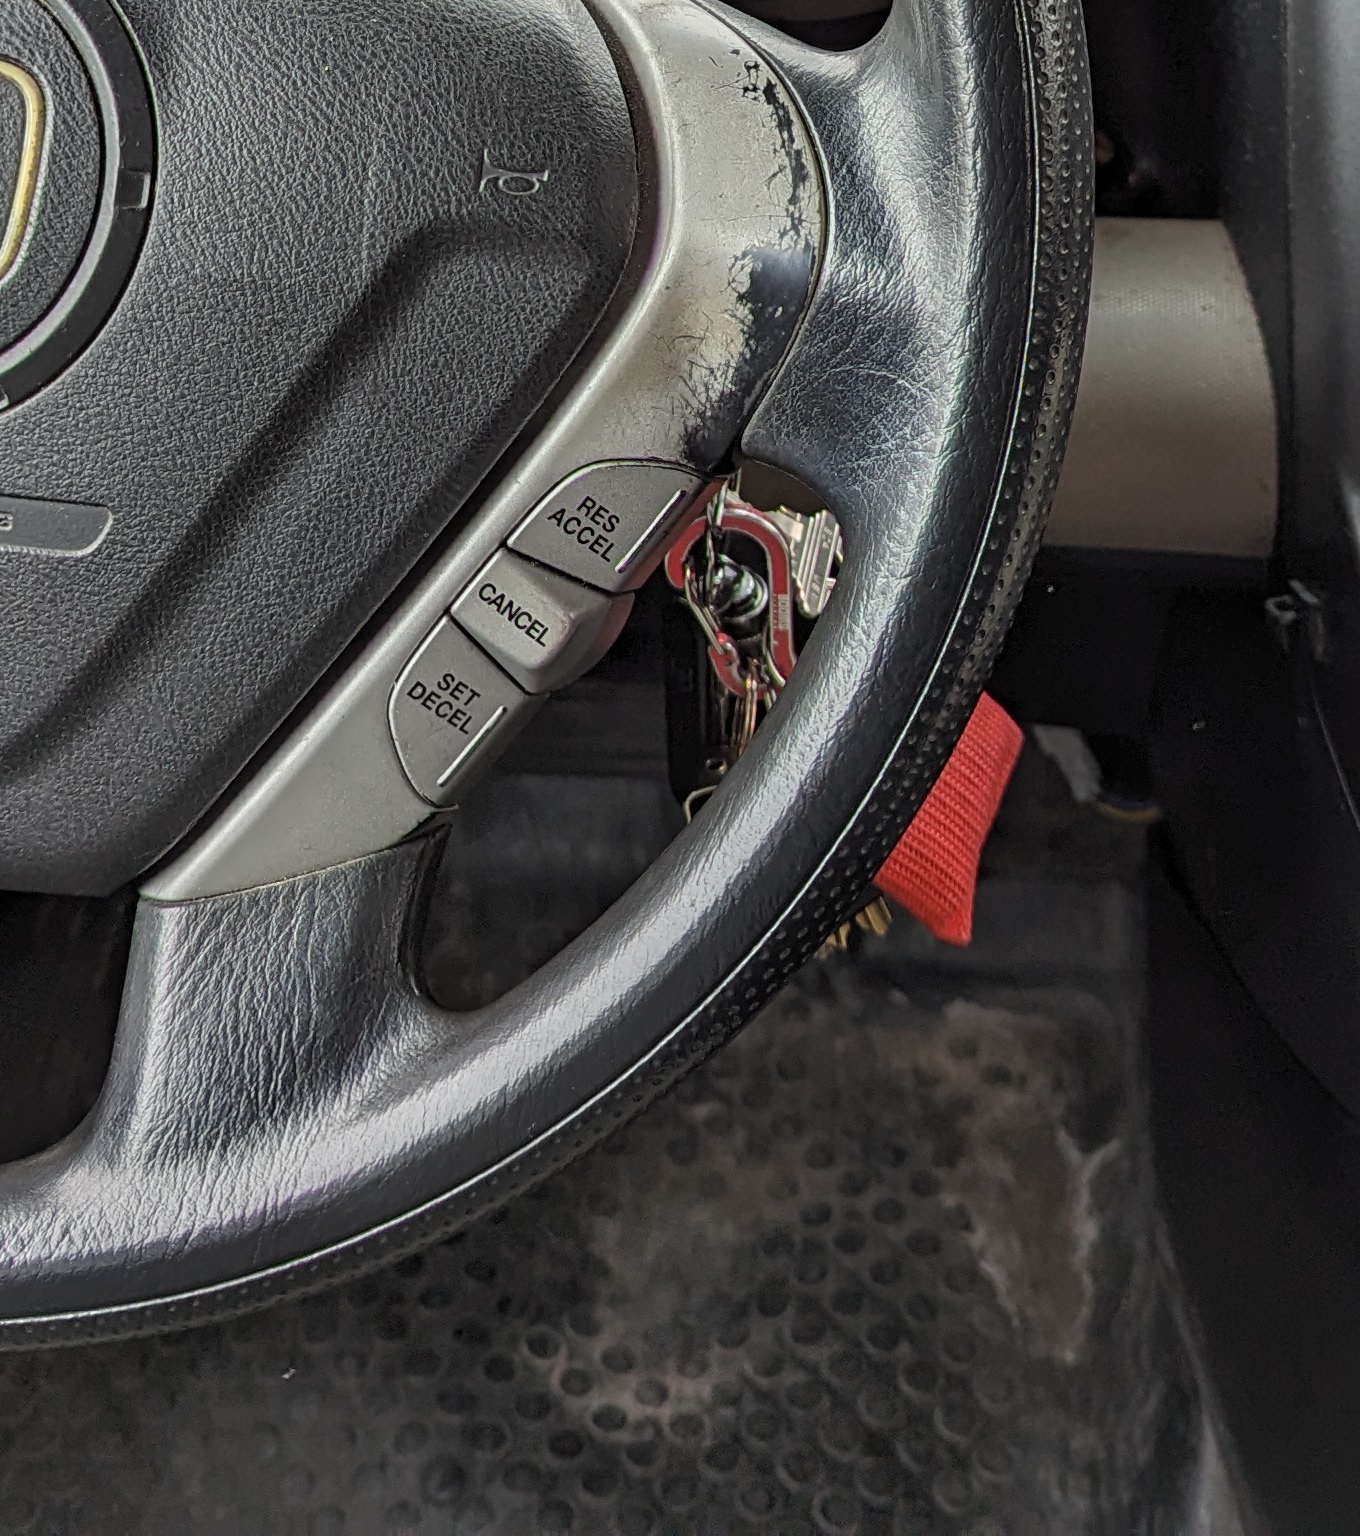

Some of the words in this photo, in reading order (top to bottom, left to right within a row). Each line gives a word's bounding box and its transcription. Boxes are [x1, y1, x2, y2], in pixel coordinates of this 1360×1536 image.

[547, 507, 621, 563] ACCEL
[575, 495, 621, 533] RES
[477, 582, 551, 648] CANCEL
[406, 680, 474, 735] DECEL
[436, 672, 482, 707] SET
